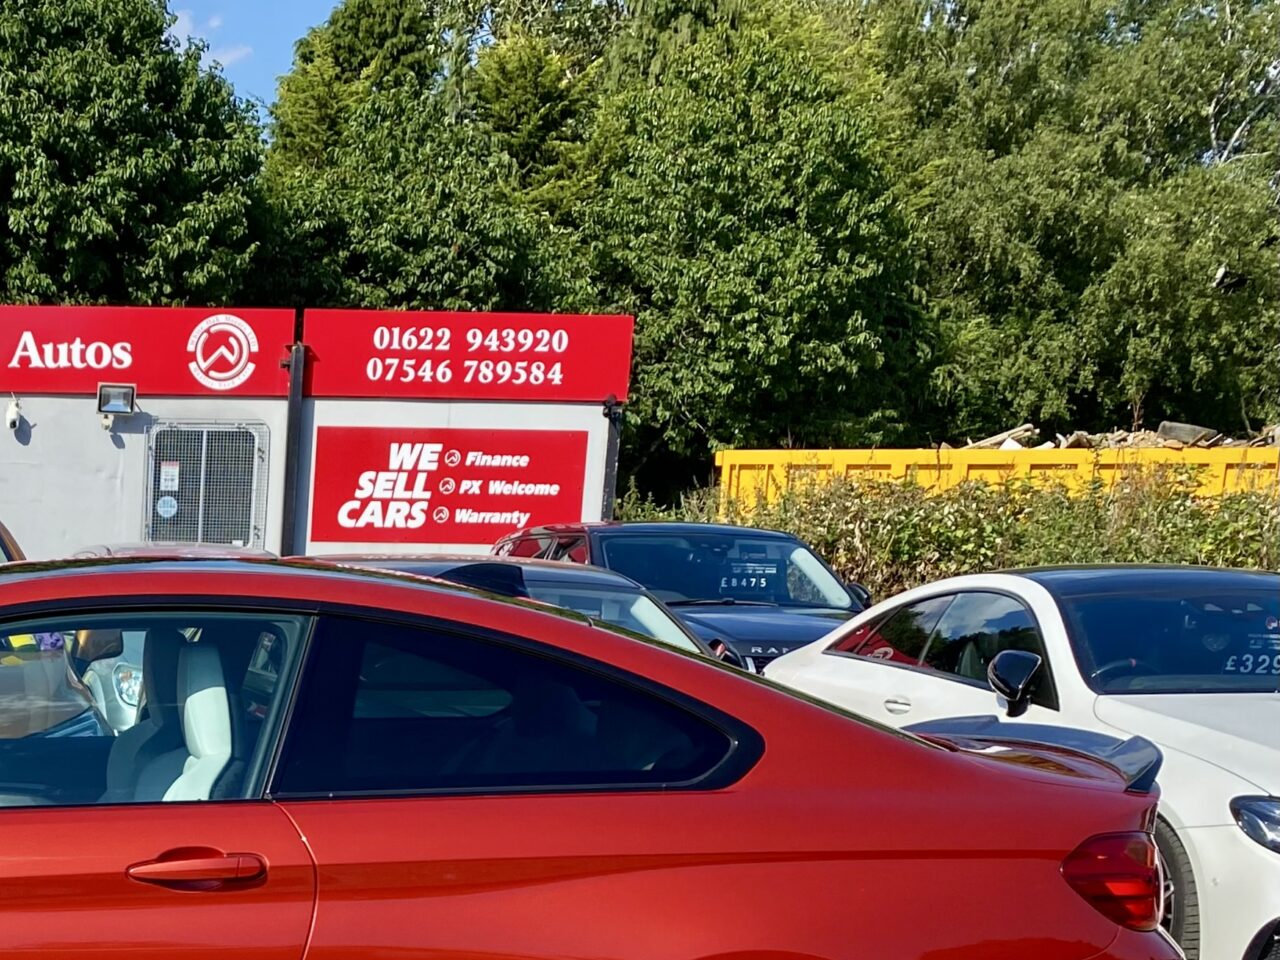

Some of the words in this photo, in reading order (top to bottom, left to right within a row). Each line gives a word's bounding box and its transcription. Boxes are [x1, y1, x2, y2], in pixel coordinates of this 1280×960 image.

[7, 331, 132, 370] Autos
[374, 327, 450, 350] 01622
[467, 329, 568, 352] 943920
[366, 358, 452, 382] 07546
[463, 361, 563, 384] 789584
[389, 442, 443, 470] WE
[465, 452, 529, 468] Finance
[354, 471, 432, 499] SELL
[459, 480, 482, 494] PX
[488, 481, 560, 496] Welcome
[338, 500, 428, 528] CARS
[454, 509, 530, 528] Warranty
[721, 578, 767, 588] £8475
